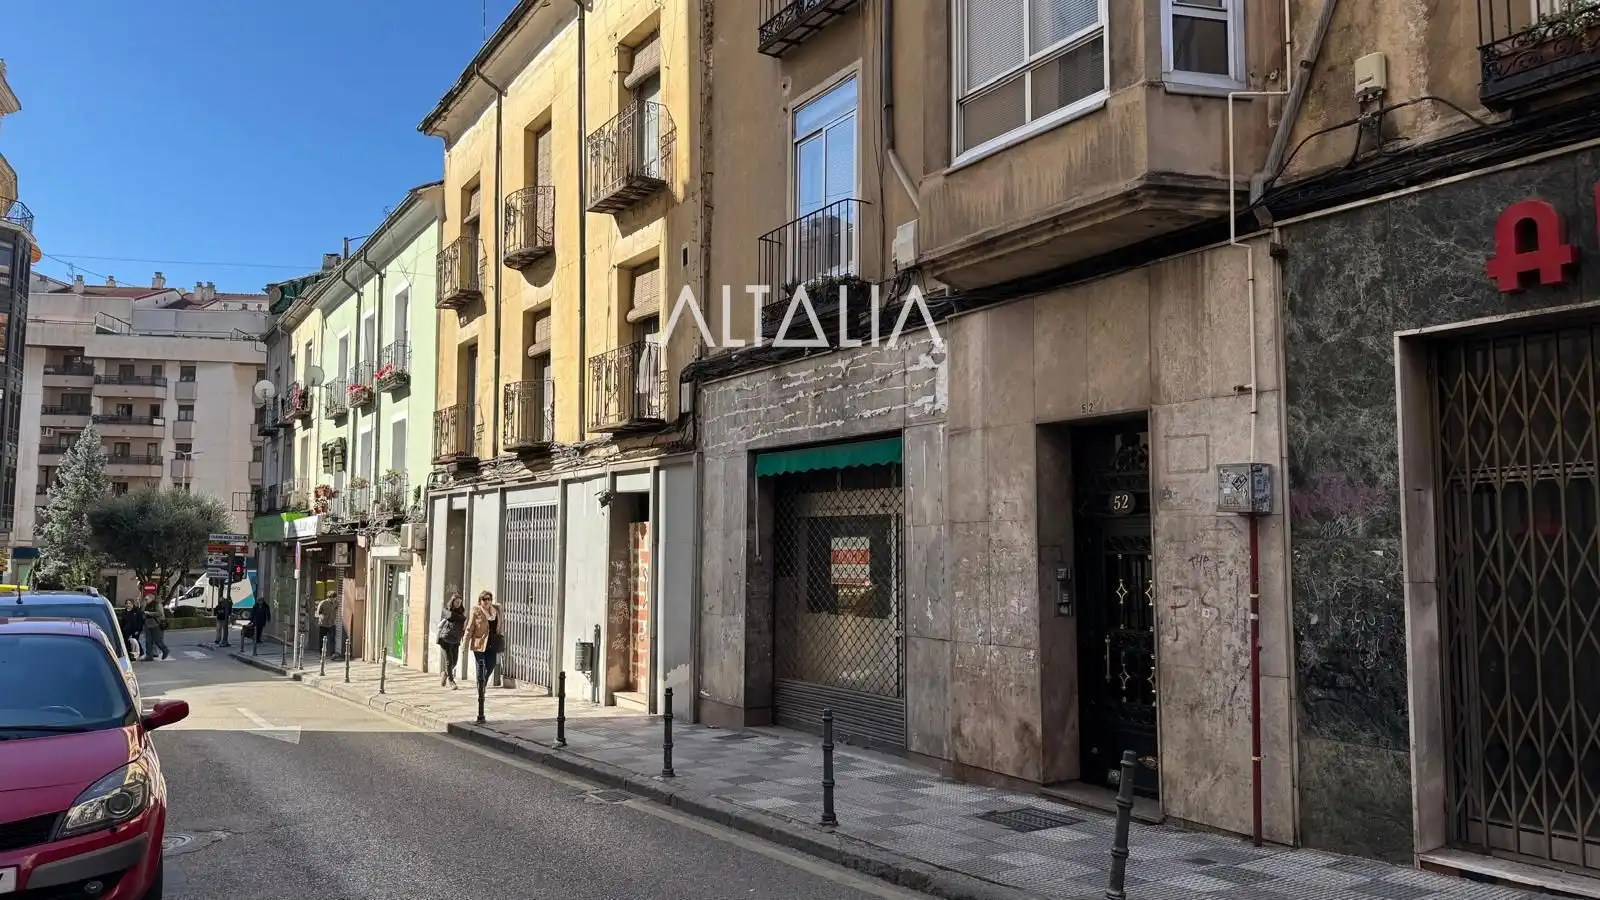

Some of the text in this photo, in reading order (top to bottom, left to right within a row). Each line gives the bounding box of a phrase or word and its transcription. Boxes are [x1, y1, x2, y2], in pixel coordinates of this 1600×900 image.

[1487, 182, 1600, 293] A
[1081, 403, 1094, 413] 52
[1113, 494, 1129, 510] 52
